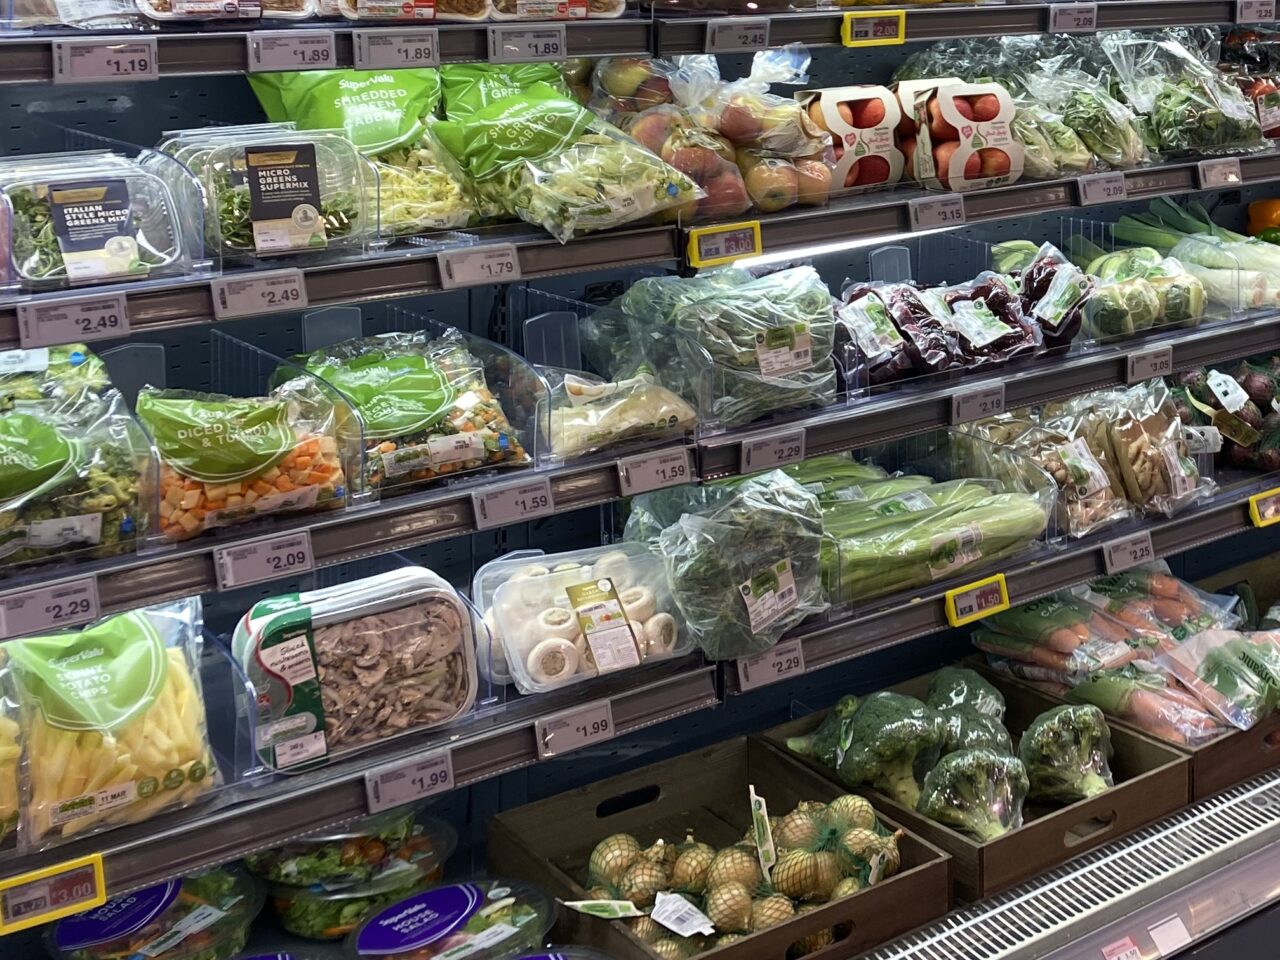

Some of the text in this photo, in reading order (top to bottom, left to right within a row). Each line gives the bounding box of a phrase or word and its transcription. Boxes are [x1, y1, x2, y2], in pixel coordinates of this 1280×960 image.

[738, 34, 764, 45] €2.45
[292, 48, 330, 62] €1.89
[397, 47, 431, 60] €1.89
[528, 43, 559, 55] €1.89
[106, 58, 148, 73] €1.19
[339, 74, 395, 91] SuperValu
[334, 88, 407, 108] SHREDDED
[348, 100, 397, 116] GREEN
[257, 169, 290, 178] MICRO
[258, 175, 298, 184] GREENS
[259, 181, 309, 191] SUPERMIX
[1103, 186, 1123, 197] €2.09
[63, 205, 102, 214] ITALIAN
[64, 209, 129, 220] STYLE MICRO
[938, 209, 961, 221] €3.15
[65, 215, 127, 226] GREENS MIX
[725, 239, 752, 253] €3.00
[480, 261, 514, 277] €1.79
[261, 288, 299, 304] €2.49
[75, 315, 118, 332] €2.49
[1150, 360, 1169, 372] €3.05
[979, 398, 1001, 413] €2.19
[177, 423, 223, 438] DICED
[202, 438, 212, 448] &
[774, 444, 801, 460] €2.29
[656, 464, 685, 482] €1.59
[514, 495, 548, 511] €1.59
[265, 551, 307, 570] €2.09
[1129, 546, 1151, 560] €2.25
[976, 593, 1000, 608] €1.50
[45, 598, 91, 619] €2.29
[48, 647, 105, 669] SuperValu
[270, 650, 309, 668] mushrooms
[772, 657, 800, 675] €2.29
[59, 673, 111, 690] POTATO
[70, 685, 109, 700] CHIPS
[576, 719, 609, 738] €1.99
[411, 769, 449, 790] €1.99
[110, 790, 127, 801] MAR
[52, 882, 92, 903] €3.00
[99, 896, 137, 922] SALAD
[379, 903, 427, 927] SuperValu
[392, 909, 434, 931] HOUSE
[400, 913, 439, 933] SALAD
